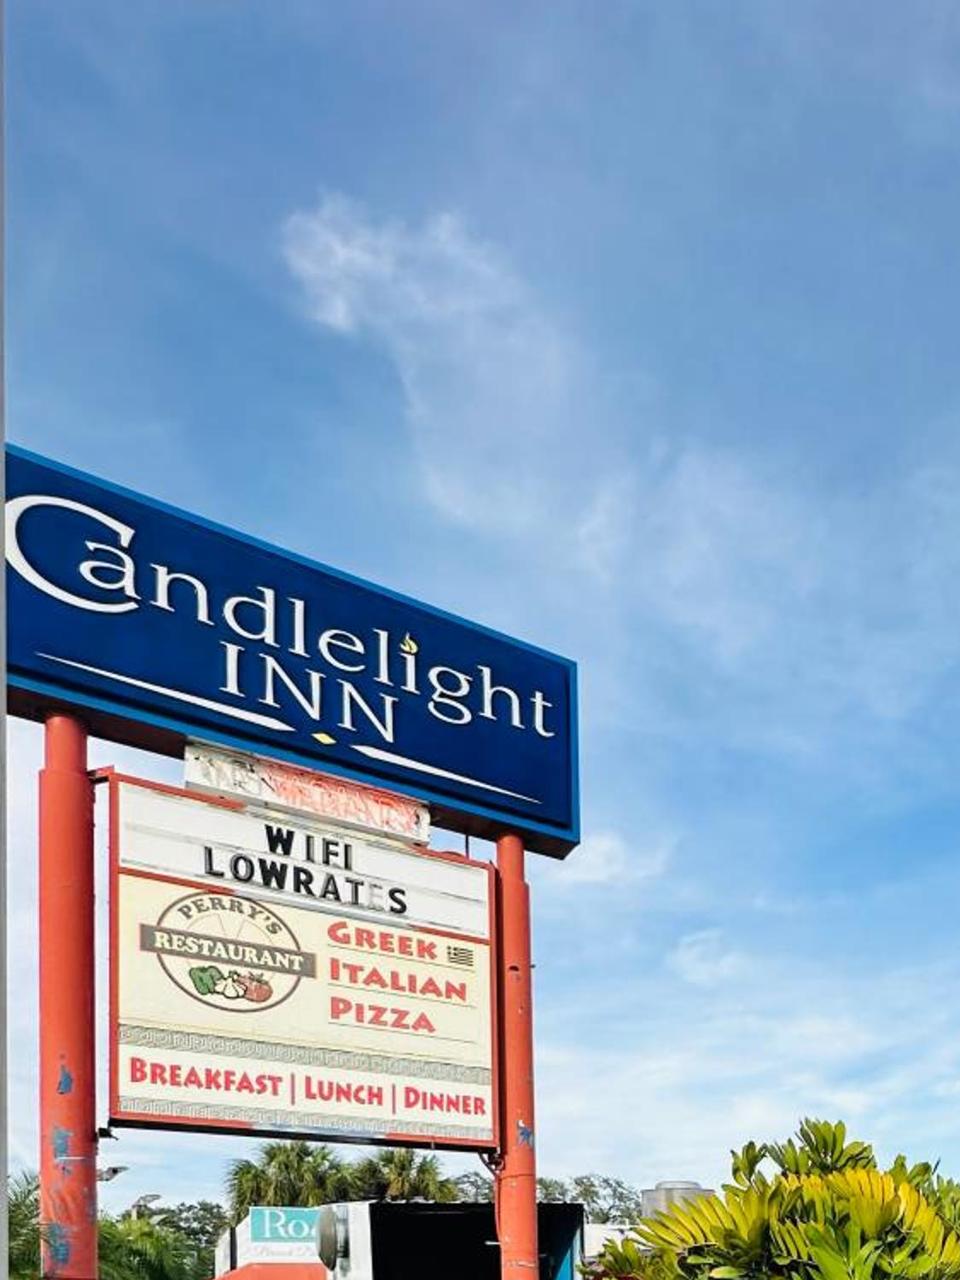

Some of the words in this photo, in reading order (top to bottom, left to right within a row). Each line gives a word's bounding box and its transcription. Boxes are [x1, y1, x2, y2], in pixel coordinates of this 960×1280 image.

[5, 495, 555, 737] Candlelight
[219, 641, 399, 743] INN
[265, 824, 353, 870] WIFI
[177, 897, 283, 935] PERRY'S
[154, 931, 304, 971] RESTAURANT
[327, 921, 438, 961] GREEK
[330, 957, 467, 1002] ITALIAN
[330, 997, 436, 1033] PIZZA
[129, 1057, 283, 1097] BREAKFAST
[304, 1076, 383, 1106] LUNCH
[403, 1086, 487, 1116] DINNER
